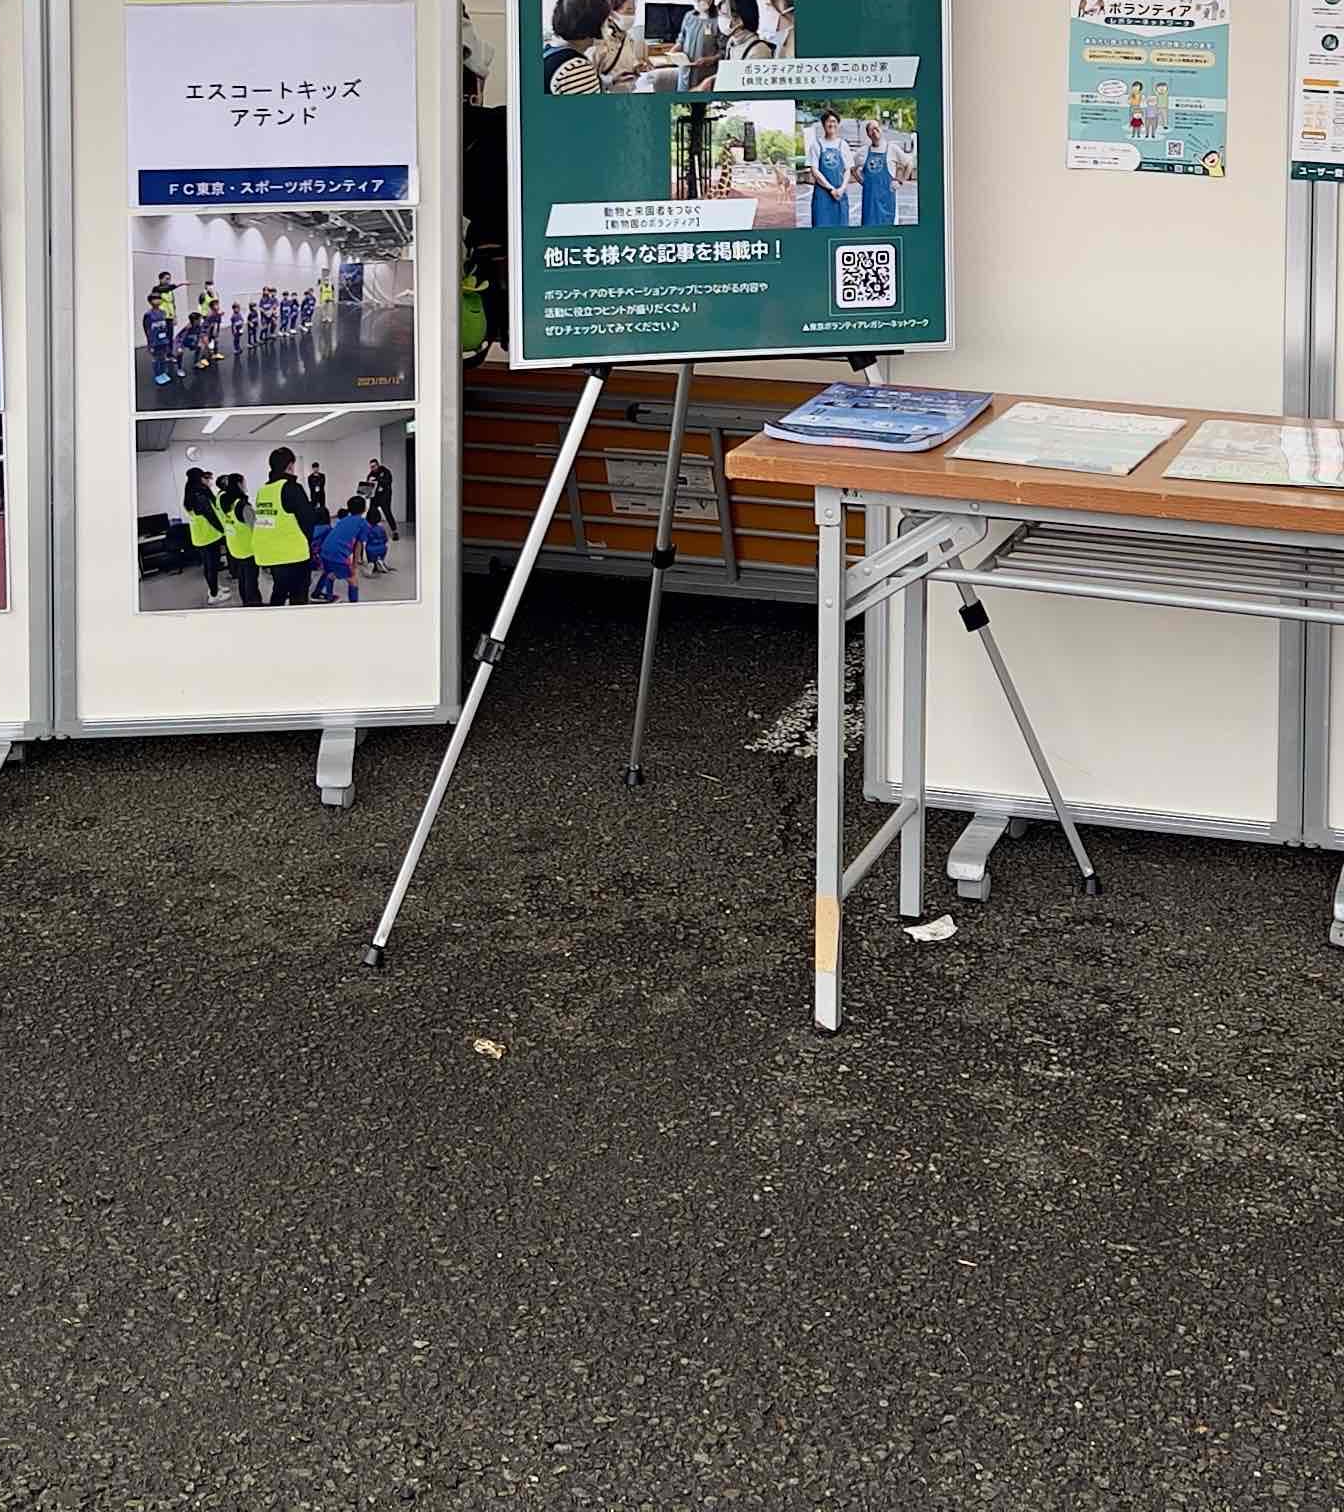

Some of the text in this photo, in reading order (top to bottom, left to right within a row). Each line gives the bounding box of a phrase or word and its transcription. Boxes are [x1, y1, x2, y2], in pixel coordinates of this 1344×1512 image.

[1108, 3, 1192, 17] ボランティア
[185, 78, 362, 101] エスコートキッズ
[229, 105, 318, 128] アテンド
[544, 239, 784, 268] 他にも様々な記事を掲載中！
